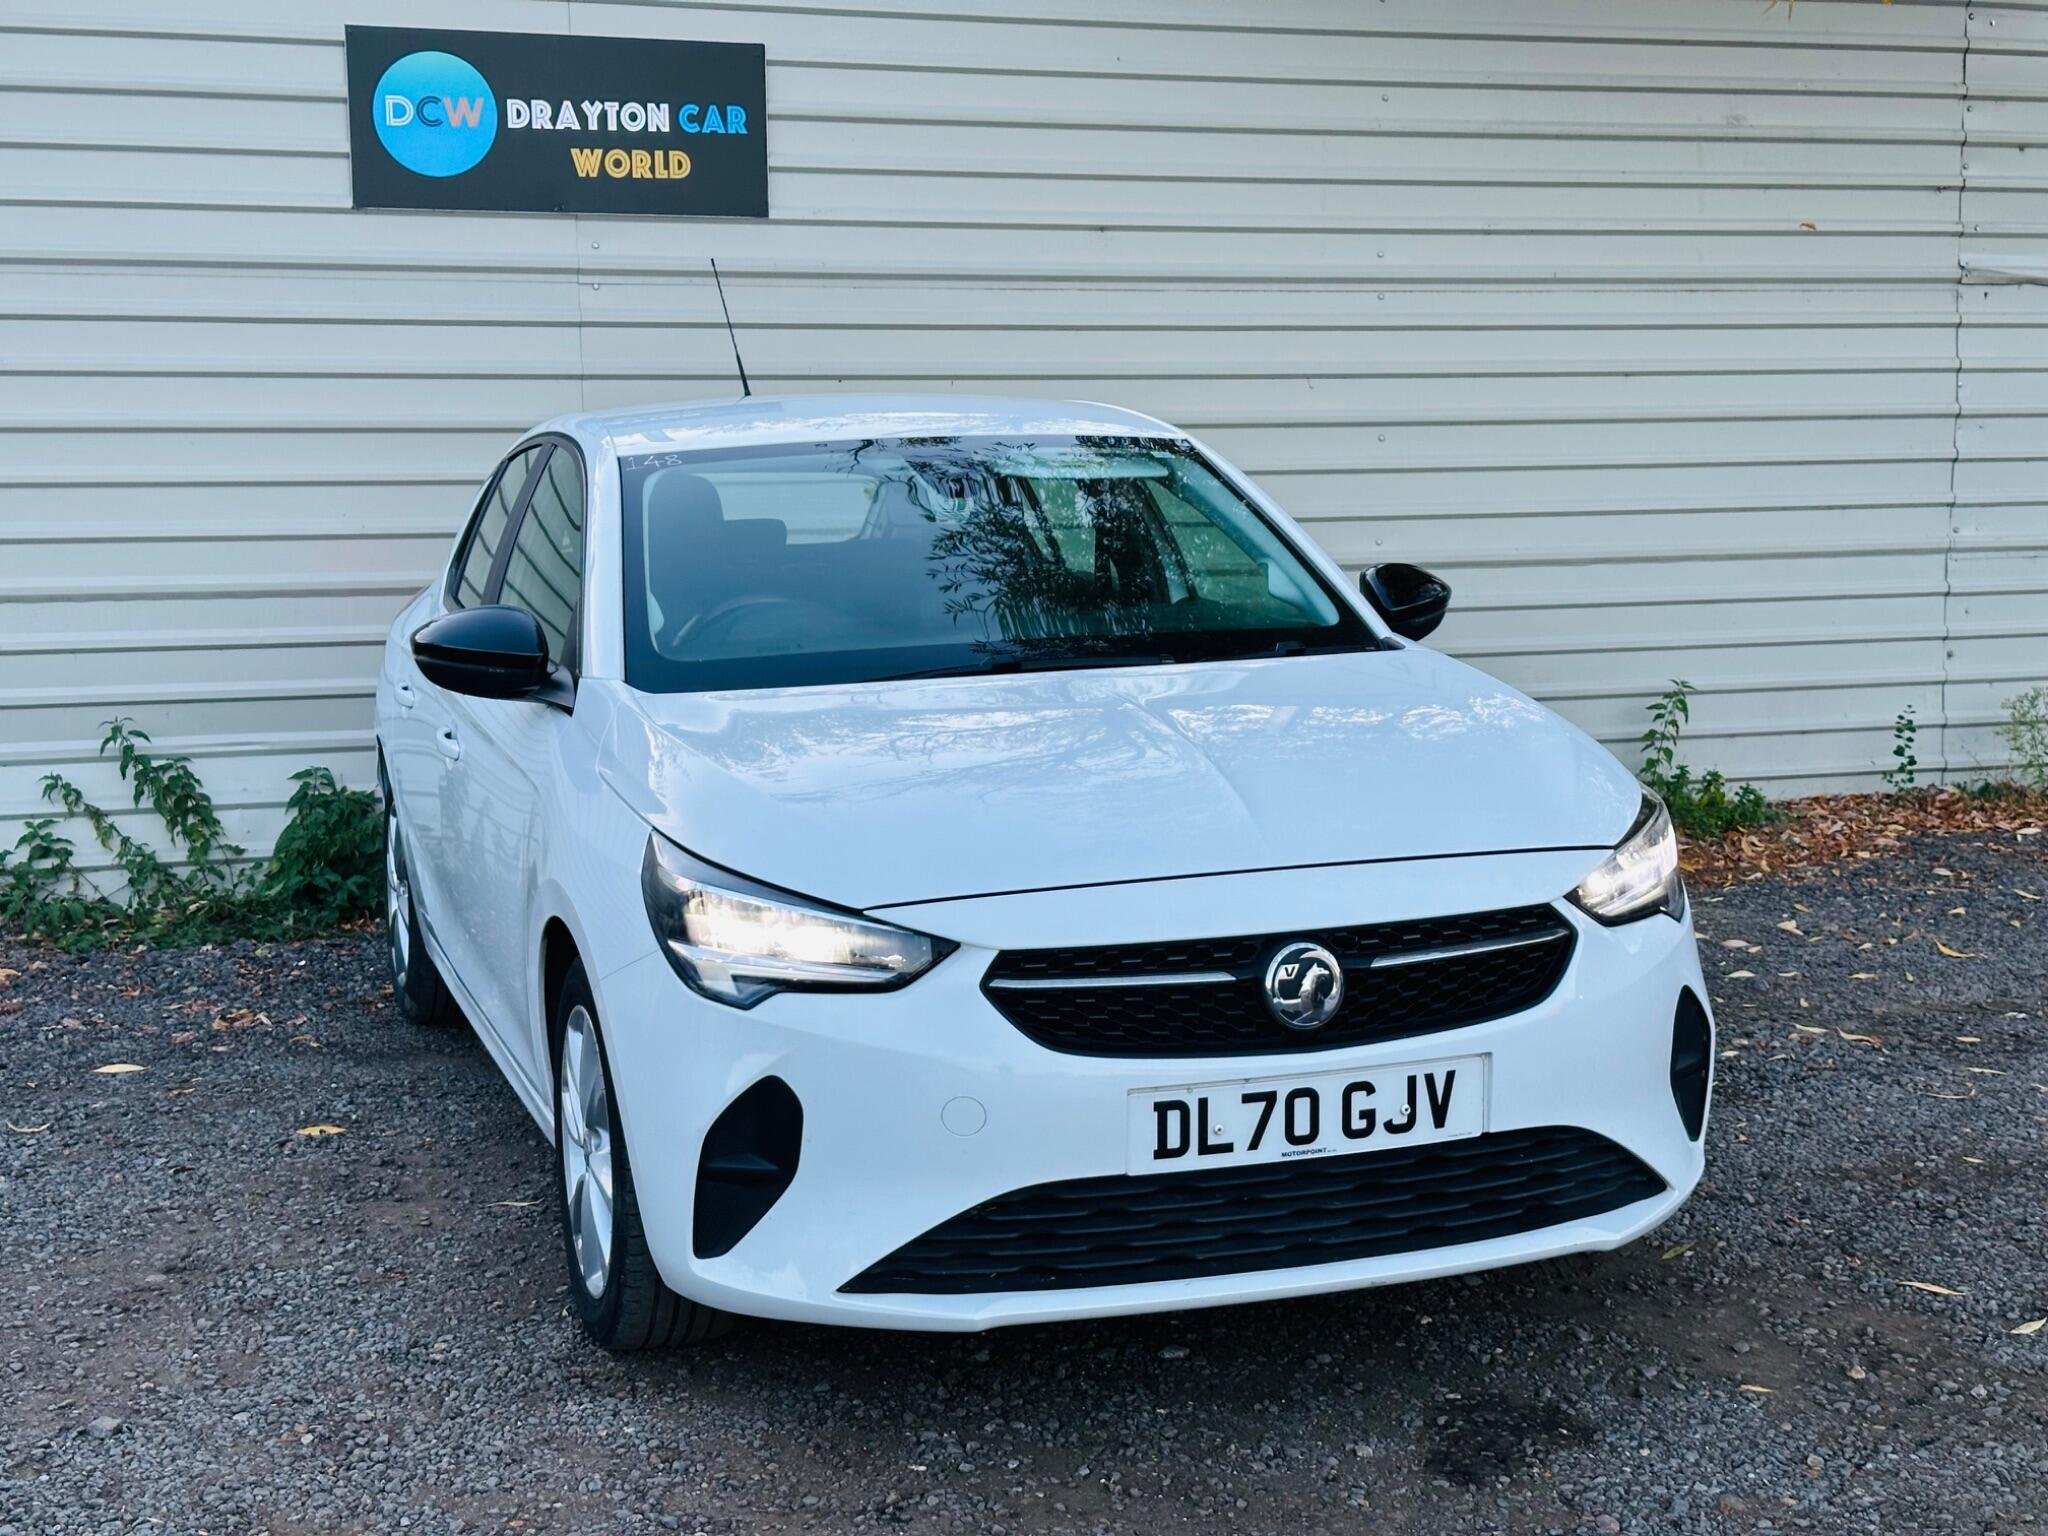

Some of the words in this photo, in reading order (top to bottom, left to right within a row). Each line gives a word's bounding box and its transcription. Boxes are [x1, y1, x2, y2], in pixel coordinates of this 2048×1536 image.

[385, 95, 484, 128] DCW
[506, 99, 670, 132] DRAYTON
[678, 104, 749, 135] CAR
[571, 148, 691, 178] WORLD
[626, 454, 683, 471] 148
[1285, 966, 1296, 977] V
[1153, 1086, 1320, 1160] DL70
[1341, 1070, 1456, 1139] GJV
